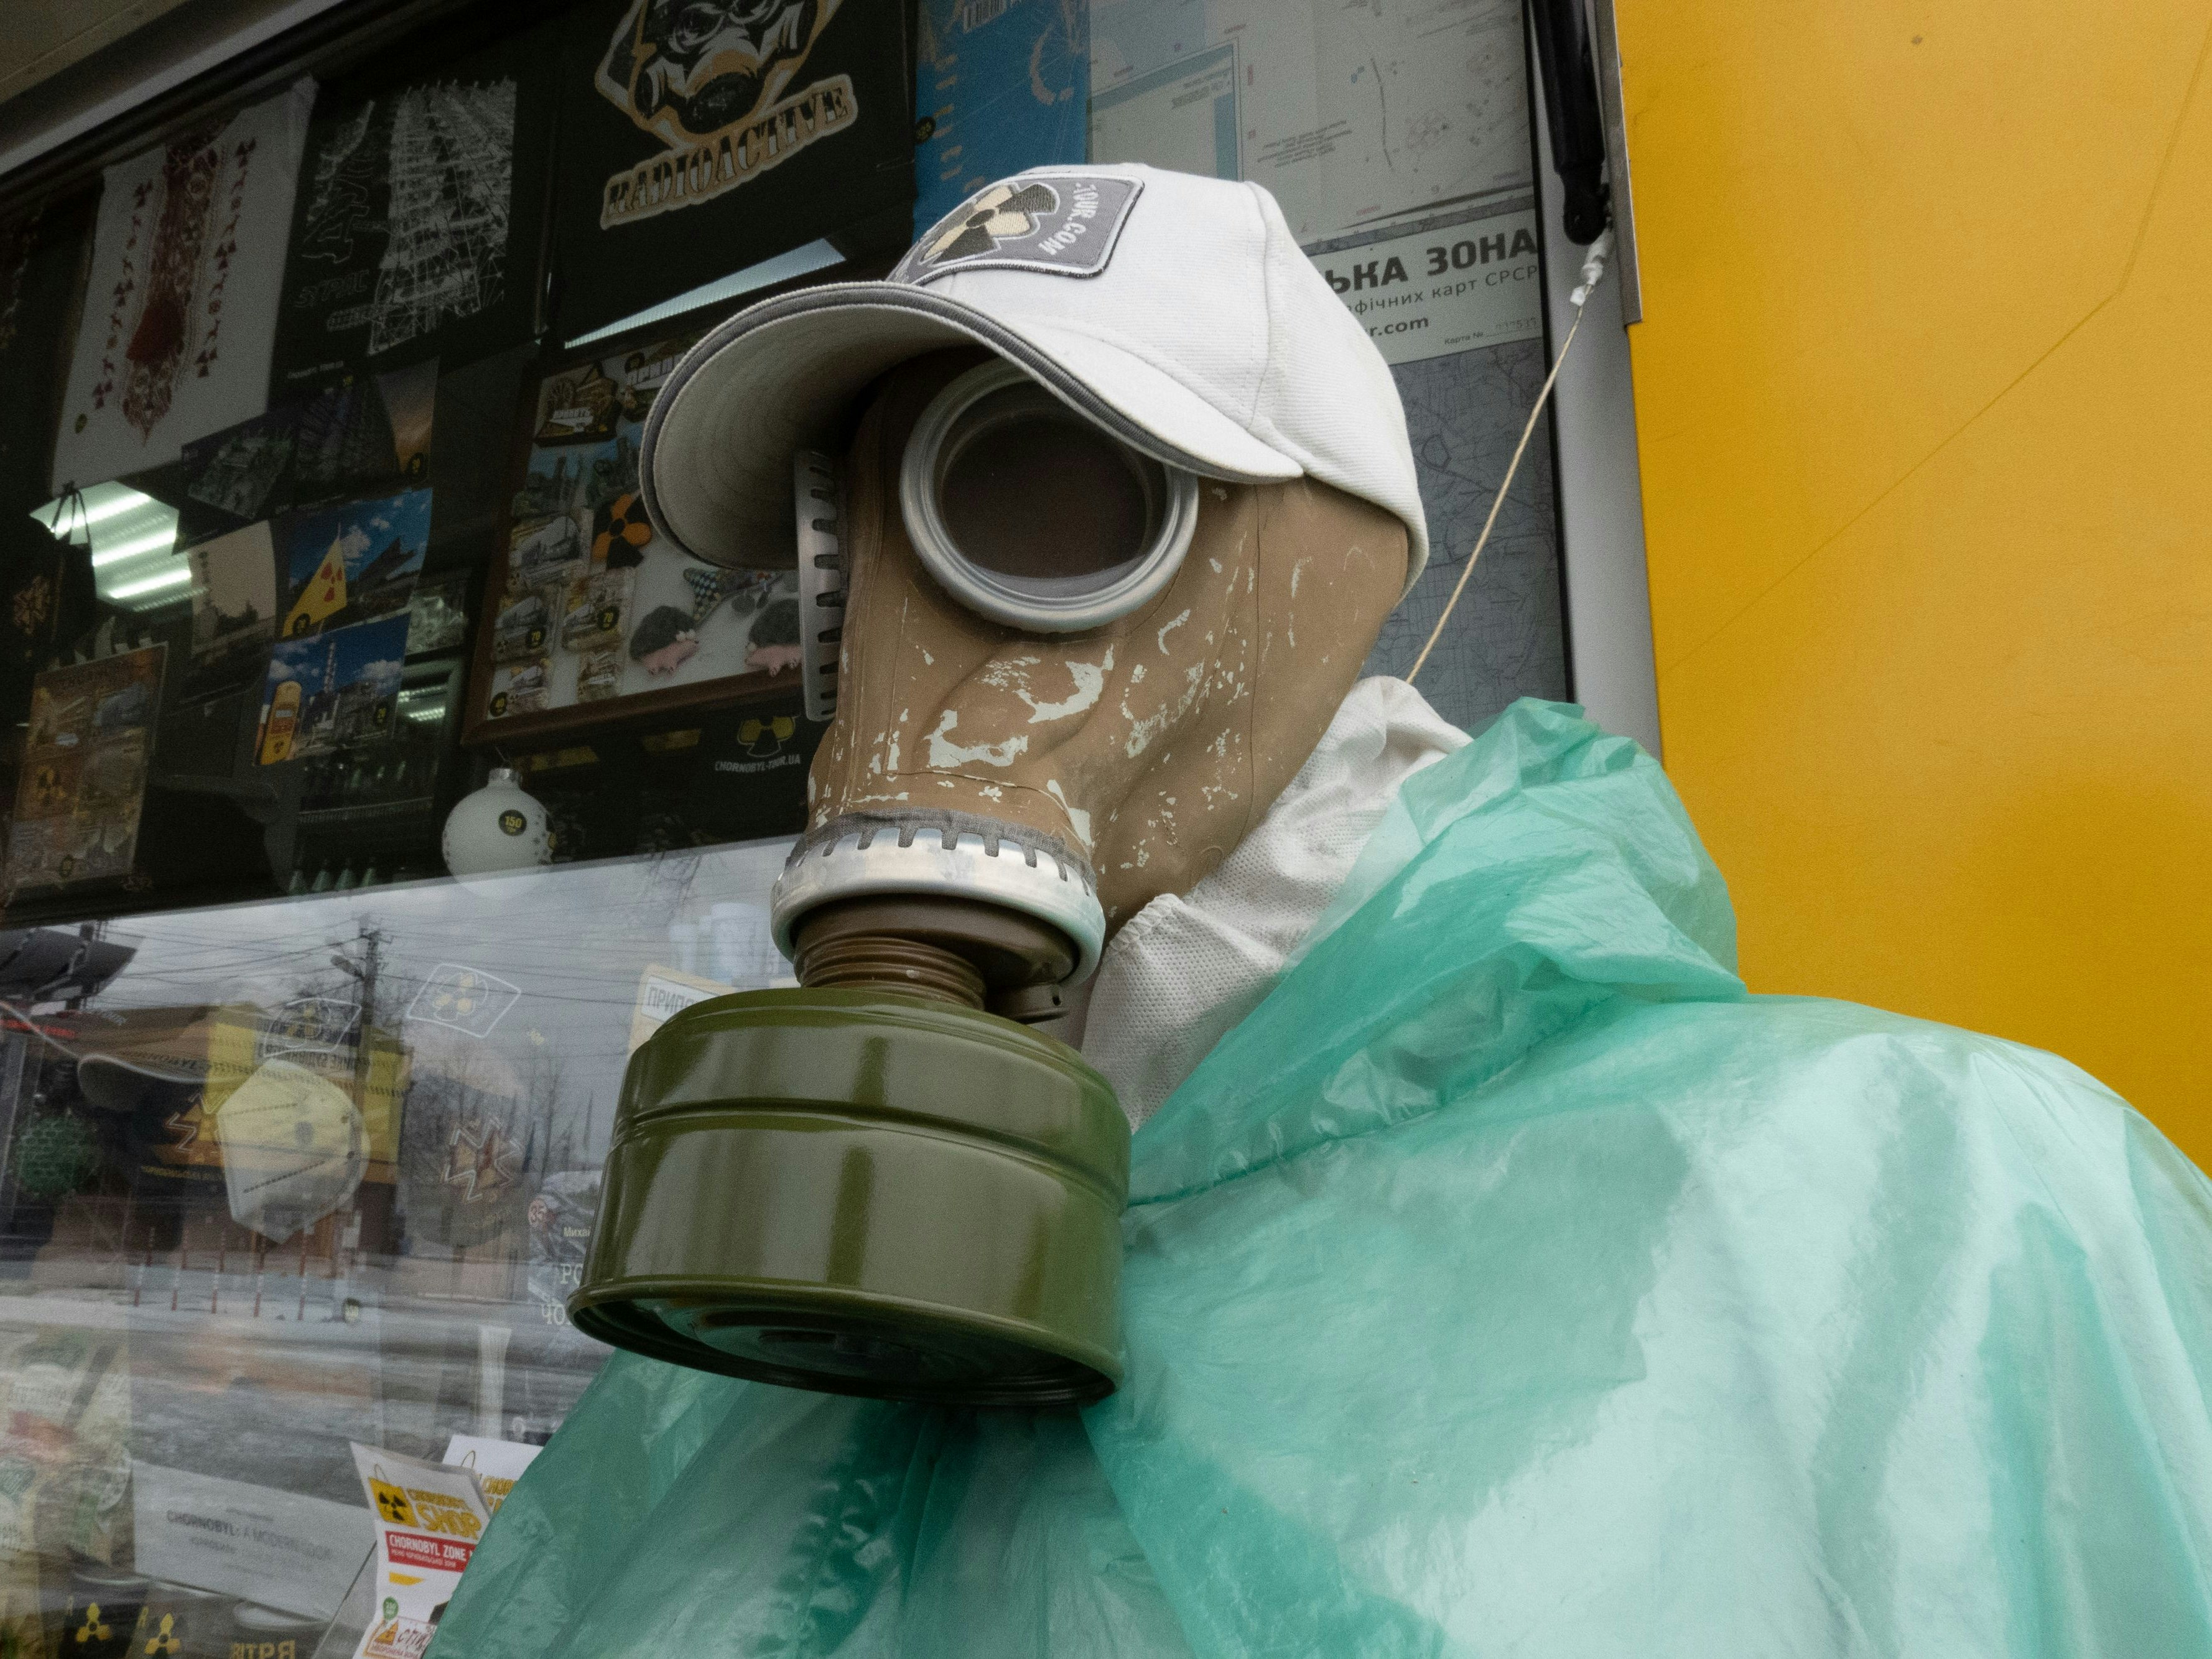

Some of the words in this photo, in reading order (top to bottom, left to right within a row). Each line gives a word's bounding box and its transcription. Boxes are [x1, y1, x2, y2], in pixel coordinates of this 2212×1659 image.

[606, 87, 848, 215] RADIOACTIVE
[1319, 256, 1408, 295] ЬКА
[1426, 227, 1538, 277] ЗОНА
[1431, 278, 1478, 299] карт
[1485, 264, 1538, 287] СРСР
[1365, 317, 1429, 338] r.com
[1444, 333, 1472, 346] Карта
[504, 816, 523, 828] 150
[541, 1304, 573, 1326] ЧО
[389, 1534, 440, 1556] CHORNOBYL
[442, 1544, 467, 1561] ZONE
